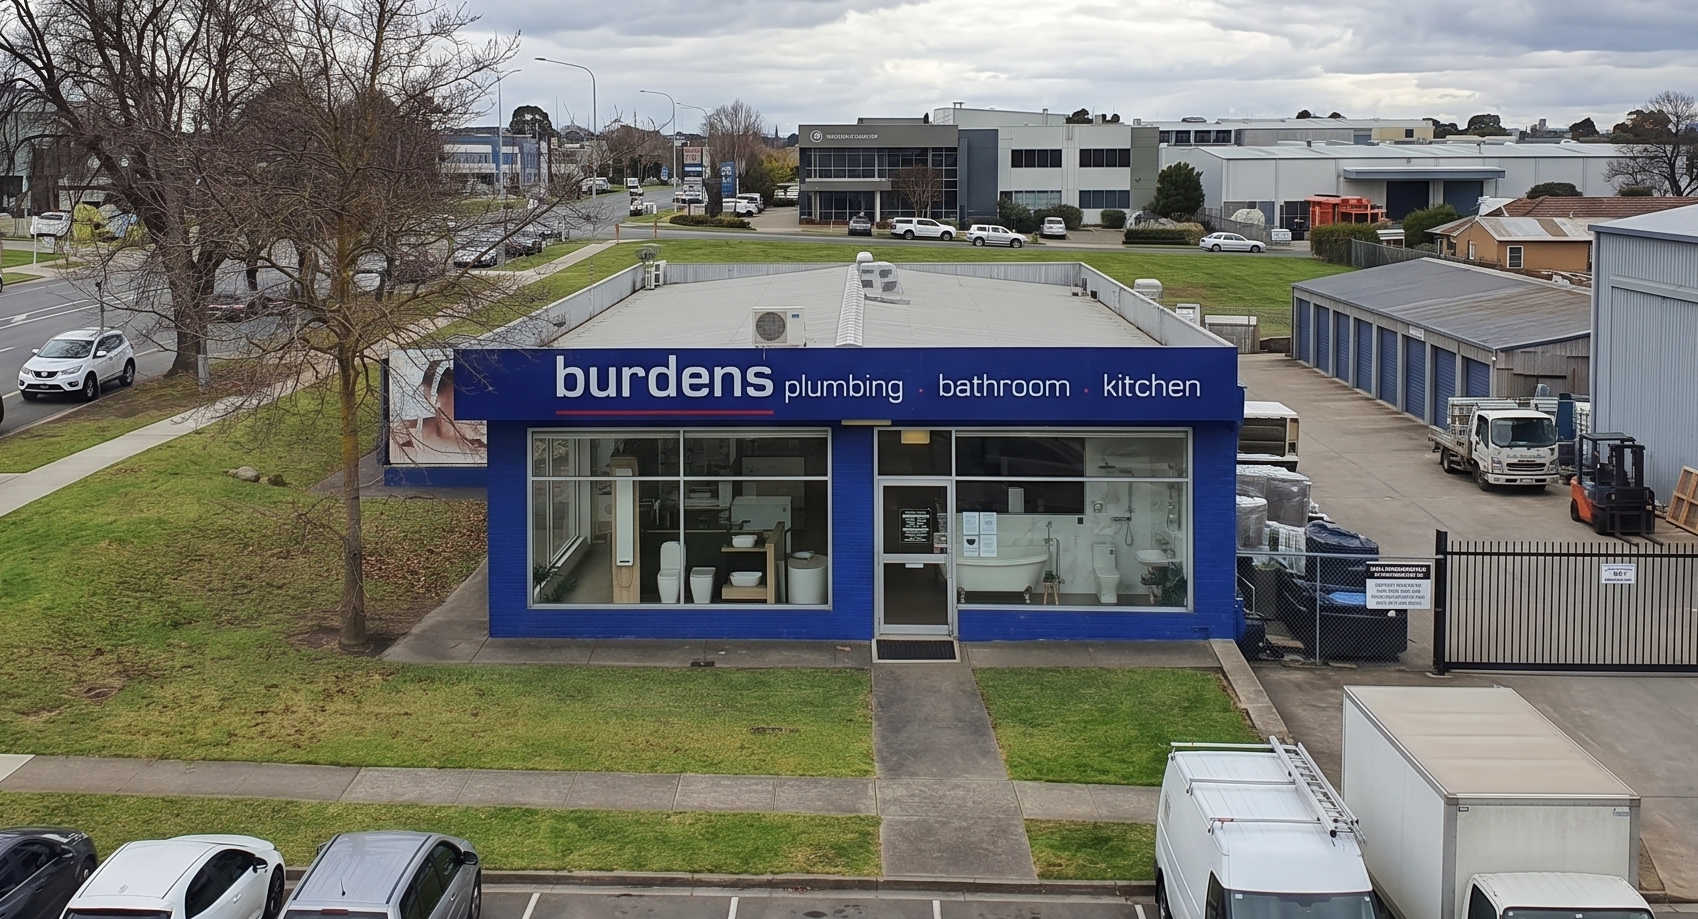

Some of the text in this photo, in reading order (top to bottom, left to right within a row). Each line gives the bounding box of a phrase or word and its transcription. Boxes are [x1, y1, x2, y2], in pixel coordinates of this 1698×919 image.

[556, 355, 1201, 403] burdens plumbing bathroom kitchen
